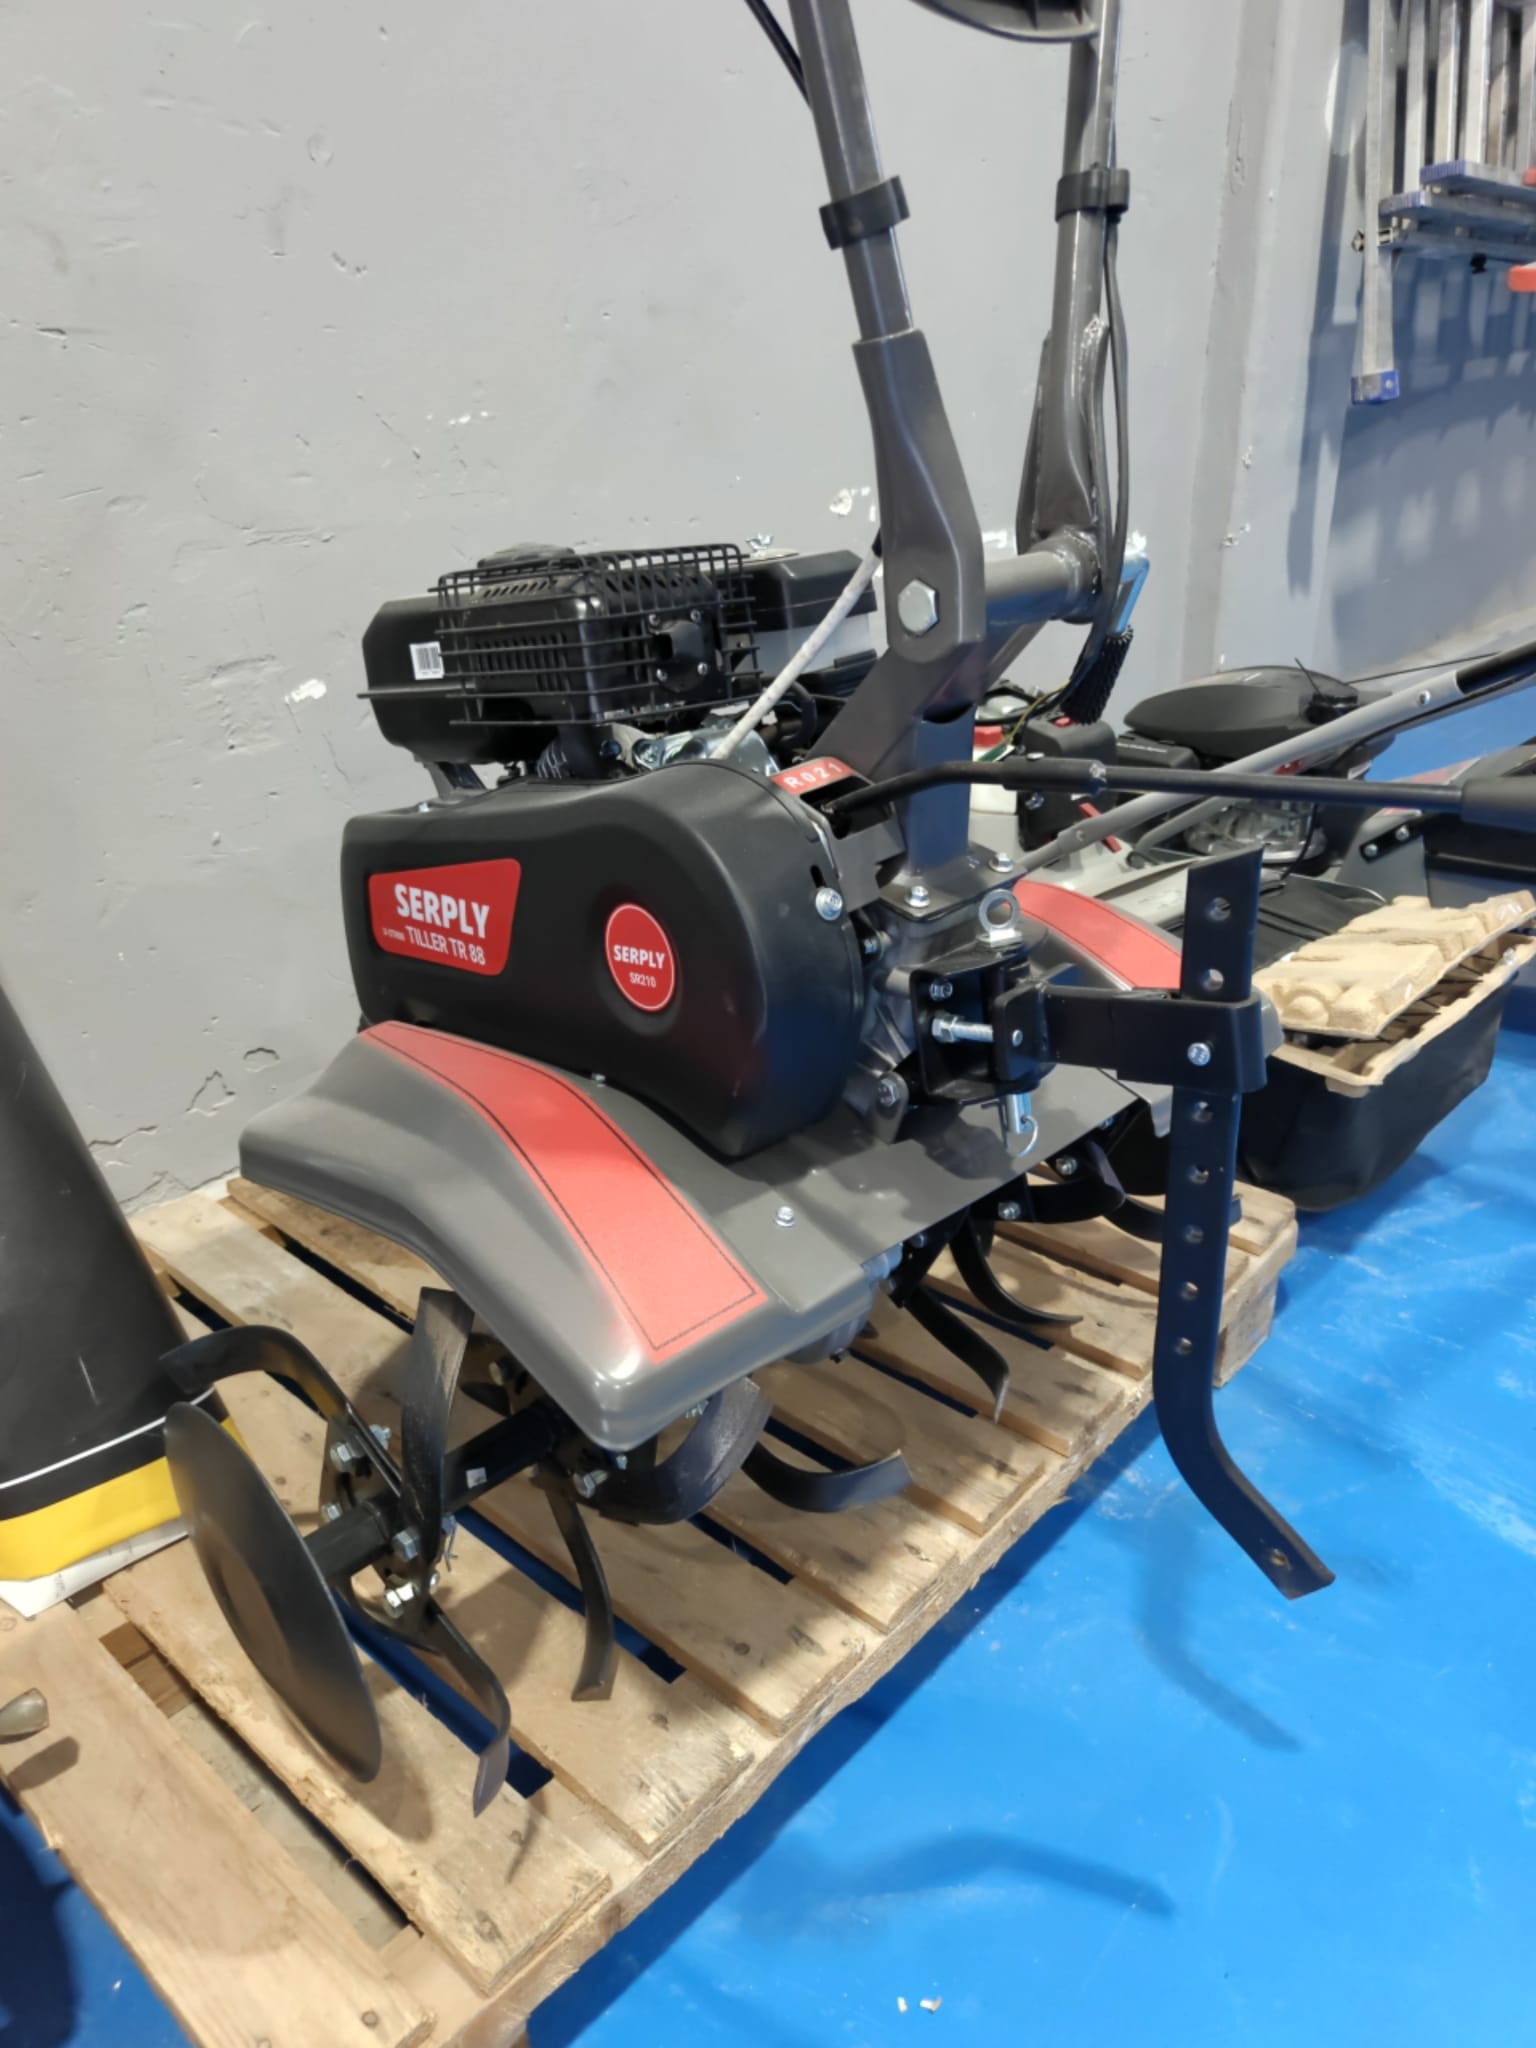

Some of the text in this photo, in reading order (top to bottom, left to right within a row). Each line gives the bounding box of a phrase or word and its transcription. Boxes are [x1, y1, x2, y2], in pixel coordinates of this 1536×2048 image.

[393, 882, 490, 939] SERPLY
[404, 925, 449, 954] TILLER
[448, 937, 468, 961] TR
[469, 943, 486, 966] 88
[613, 944, 665, 969] SERPLY
[628, 971, 657, 989] SR210
